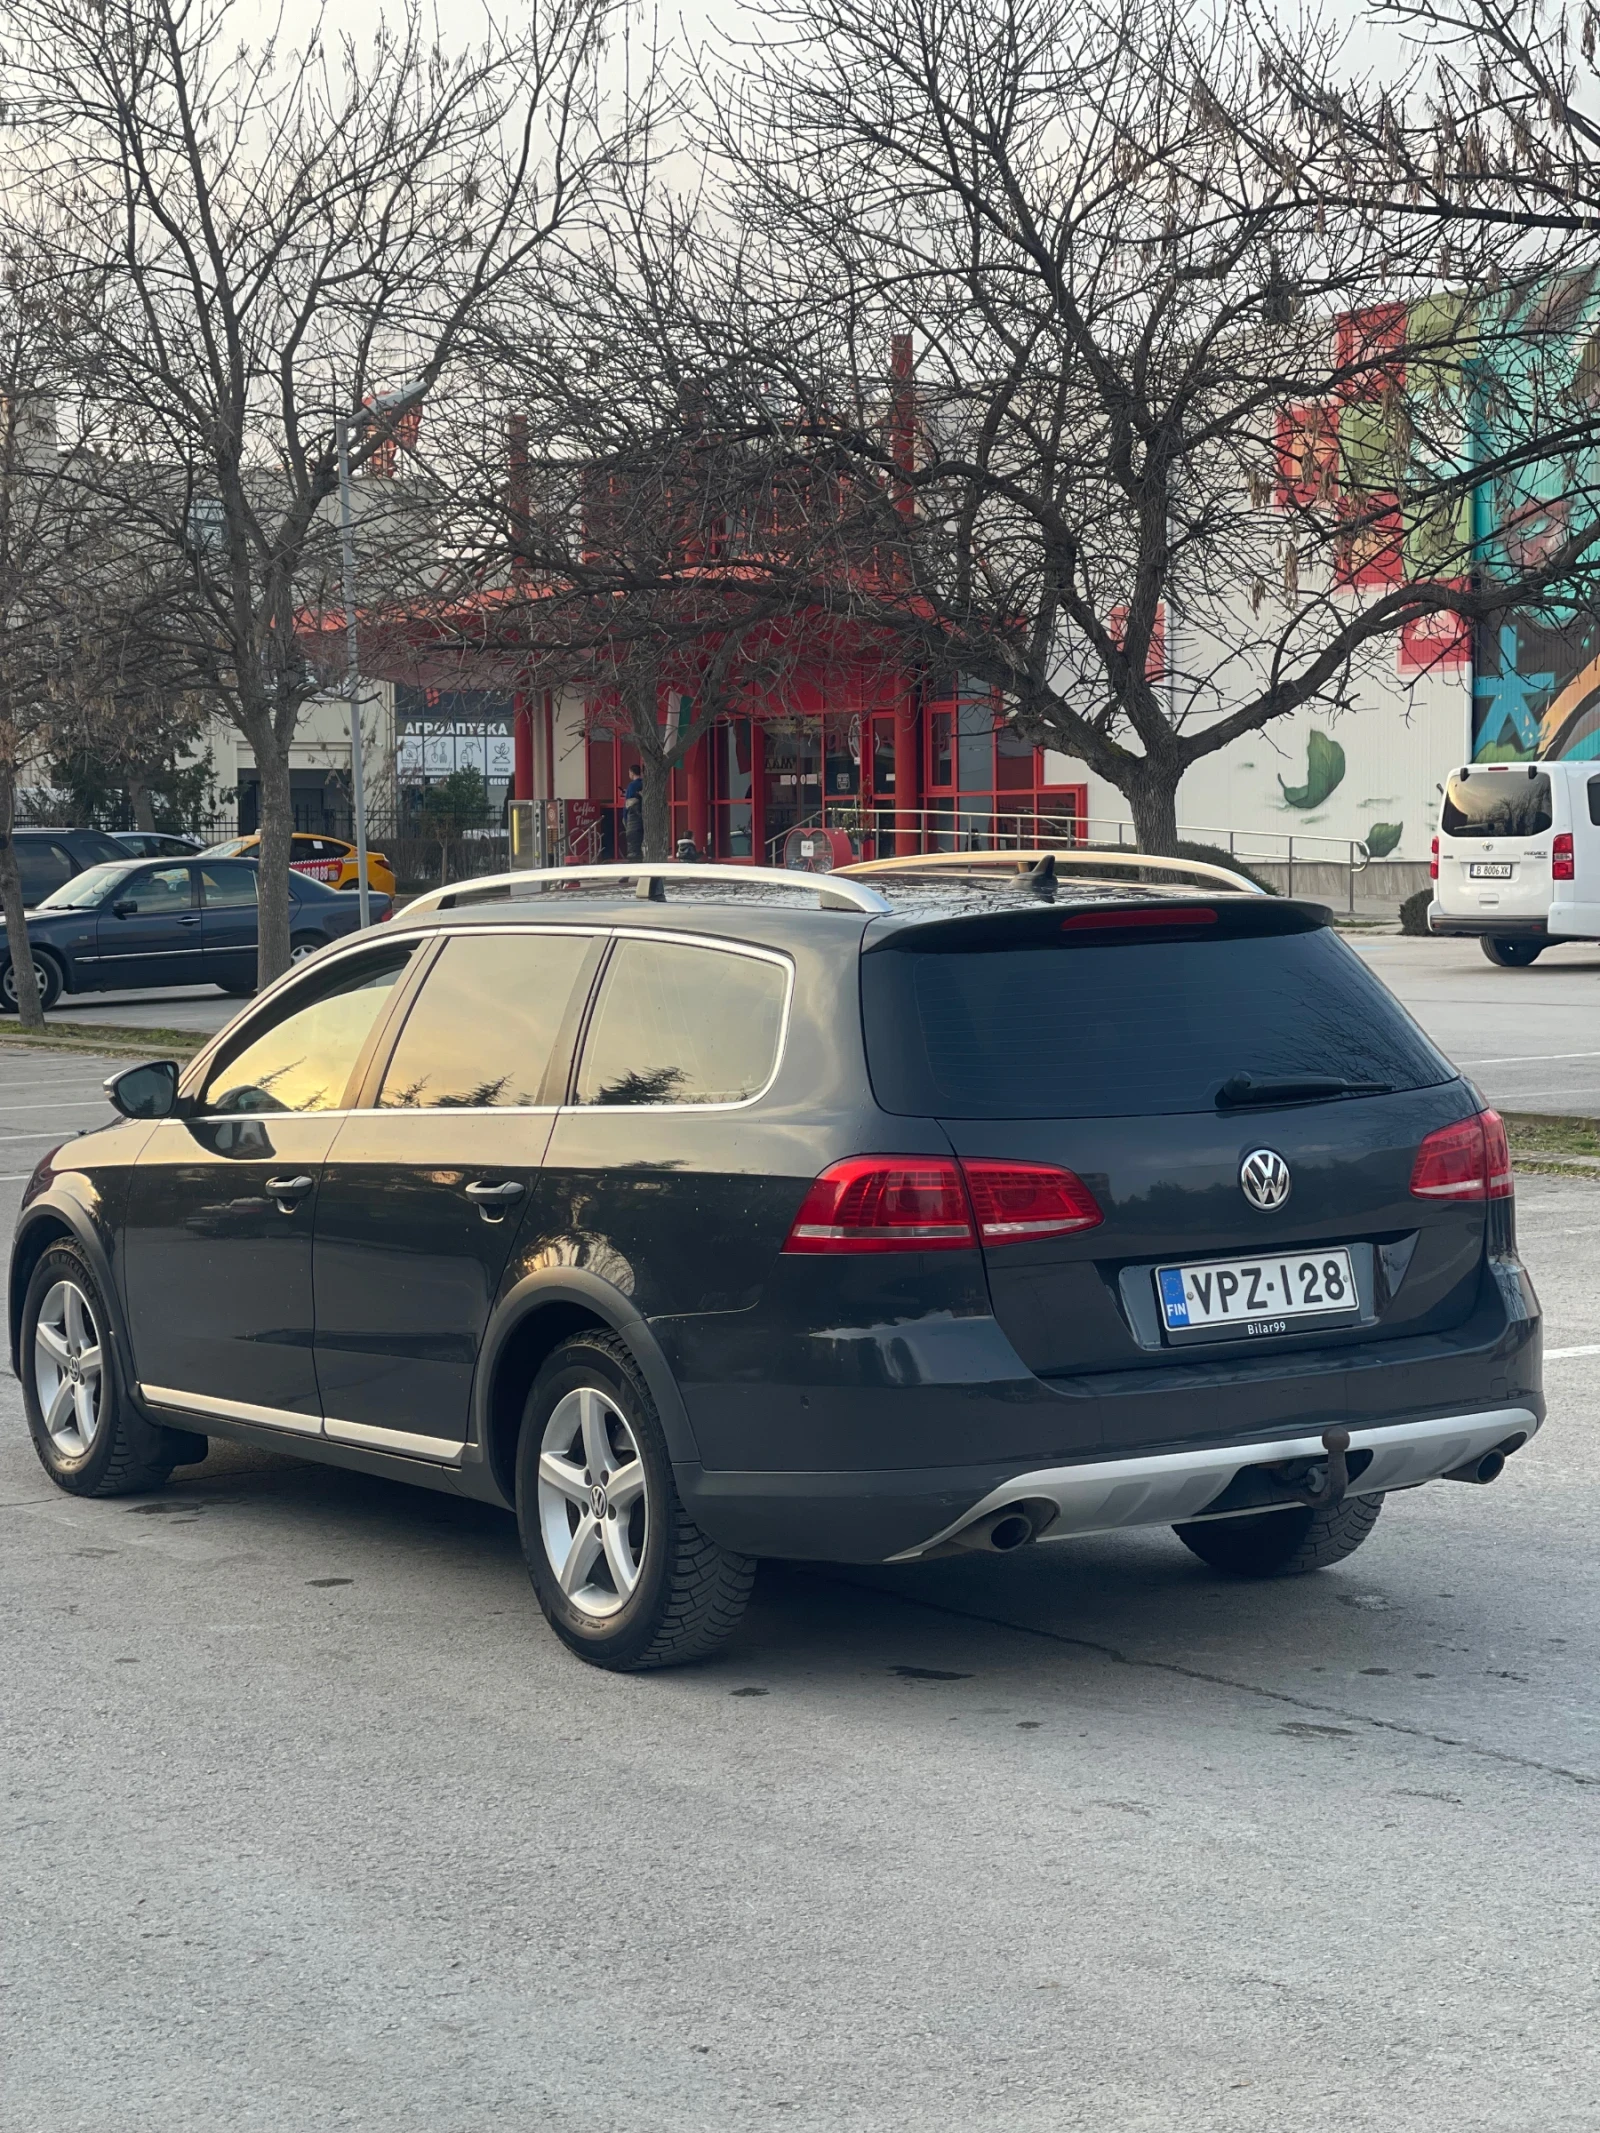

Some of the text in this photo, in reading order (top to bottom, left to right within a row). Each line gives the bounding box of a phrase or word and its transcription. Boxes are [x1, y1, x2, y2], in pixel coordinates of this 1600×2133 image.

[404, 722, 508, 735] АГРОАПТЕКА
[573, 801, 596, 816] Coffee
[1476, 865, 1509, 875] B 8006 XK
[1190, 1260, 1345, 1315] VPZ-128
[1166, 1302, 1187, 1317] FIN
[1247, 1321, 1286, 1335] Bilar99
